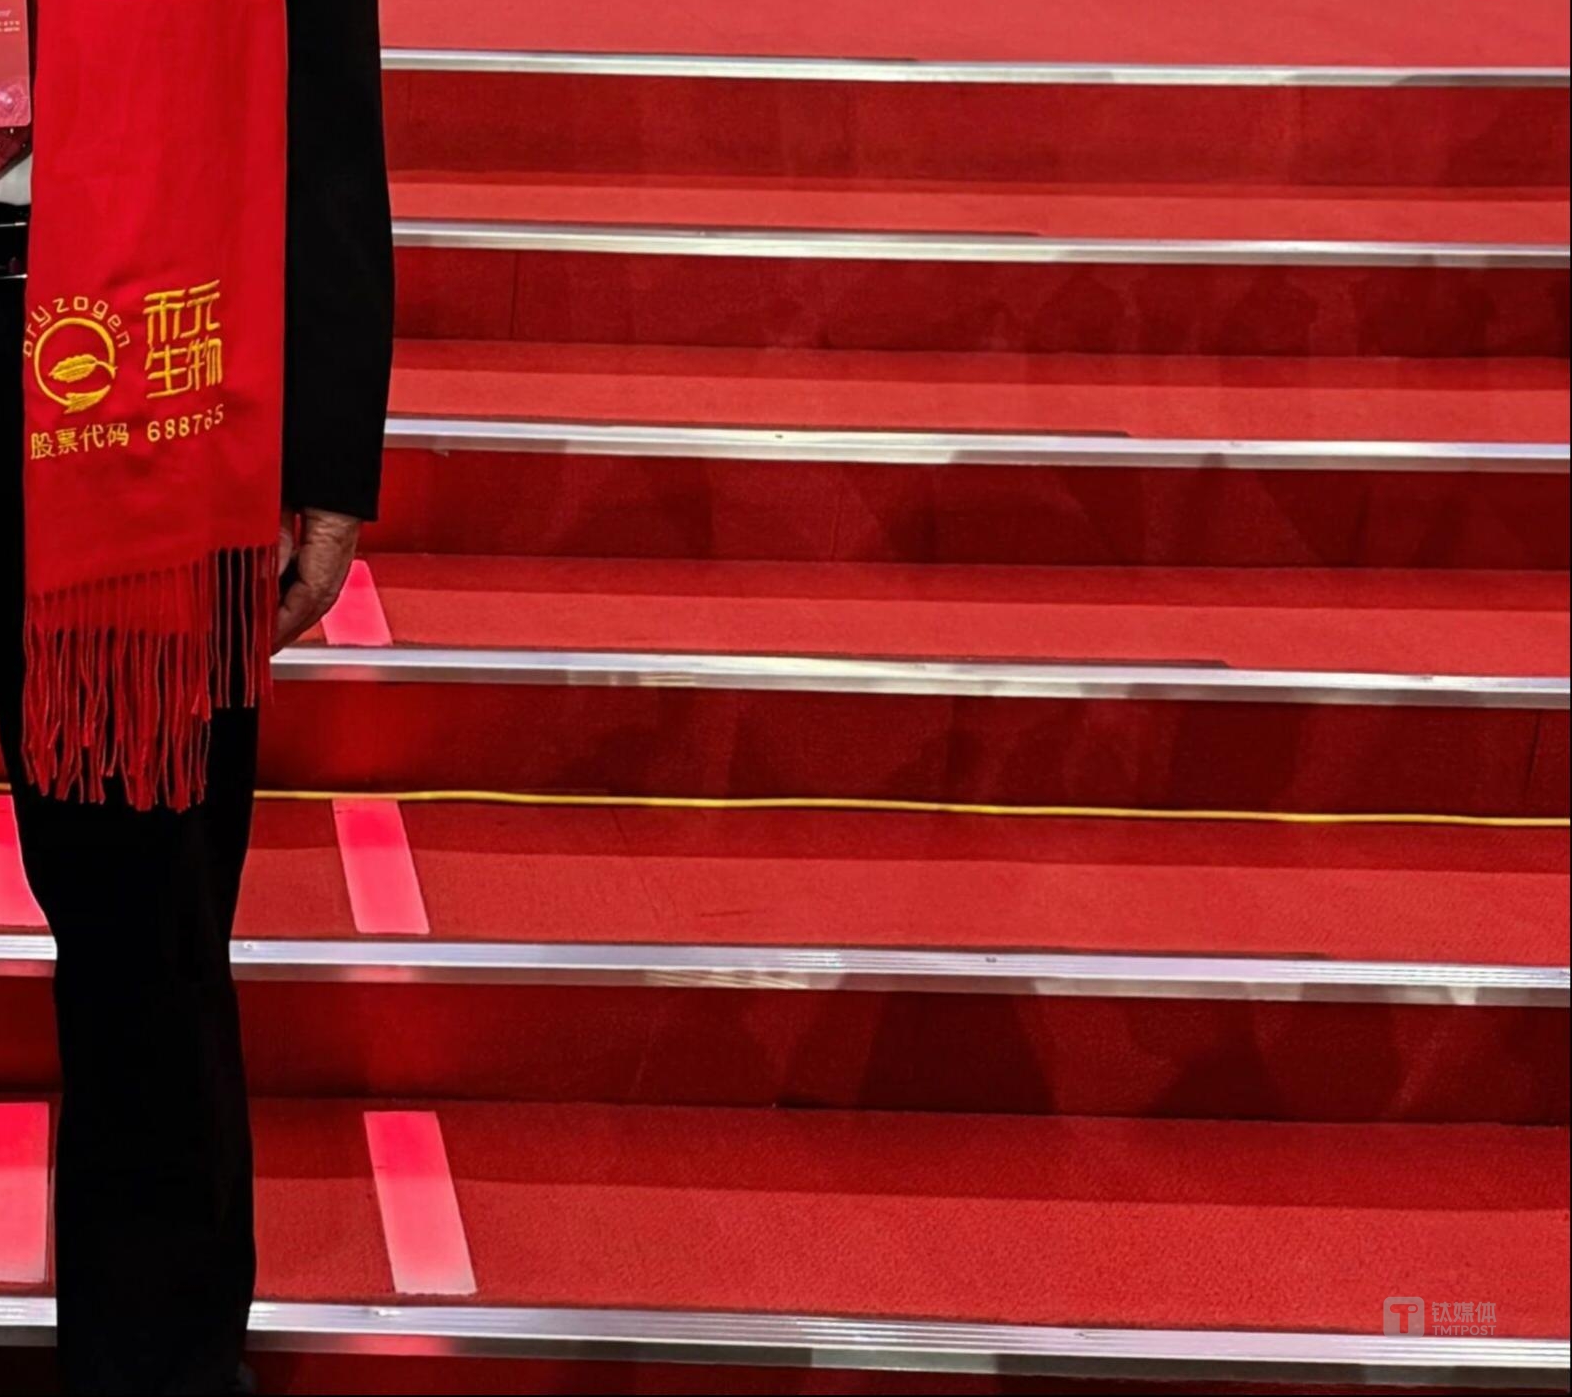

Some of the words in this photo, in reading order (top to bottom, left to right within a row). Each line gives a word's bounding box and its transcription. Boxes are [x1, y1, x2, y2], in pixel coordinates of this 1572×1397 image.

[22, 295, 131, 357] oryzogen
[144, 335, 223, 399] 生物
[30, 422, 130, 460] 股票代码
[147, 404, 224, 442] 688765
